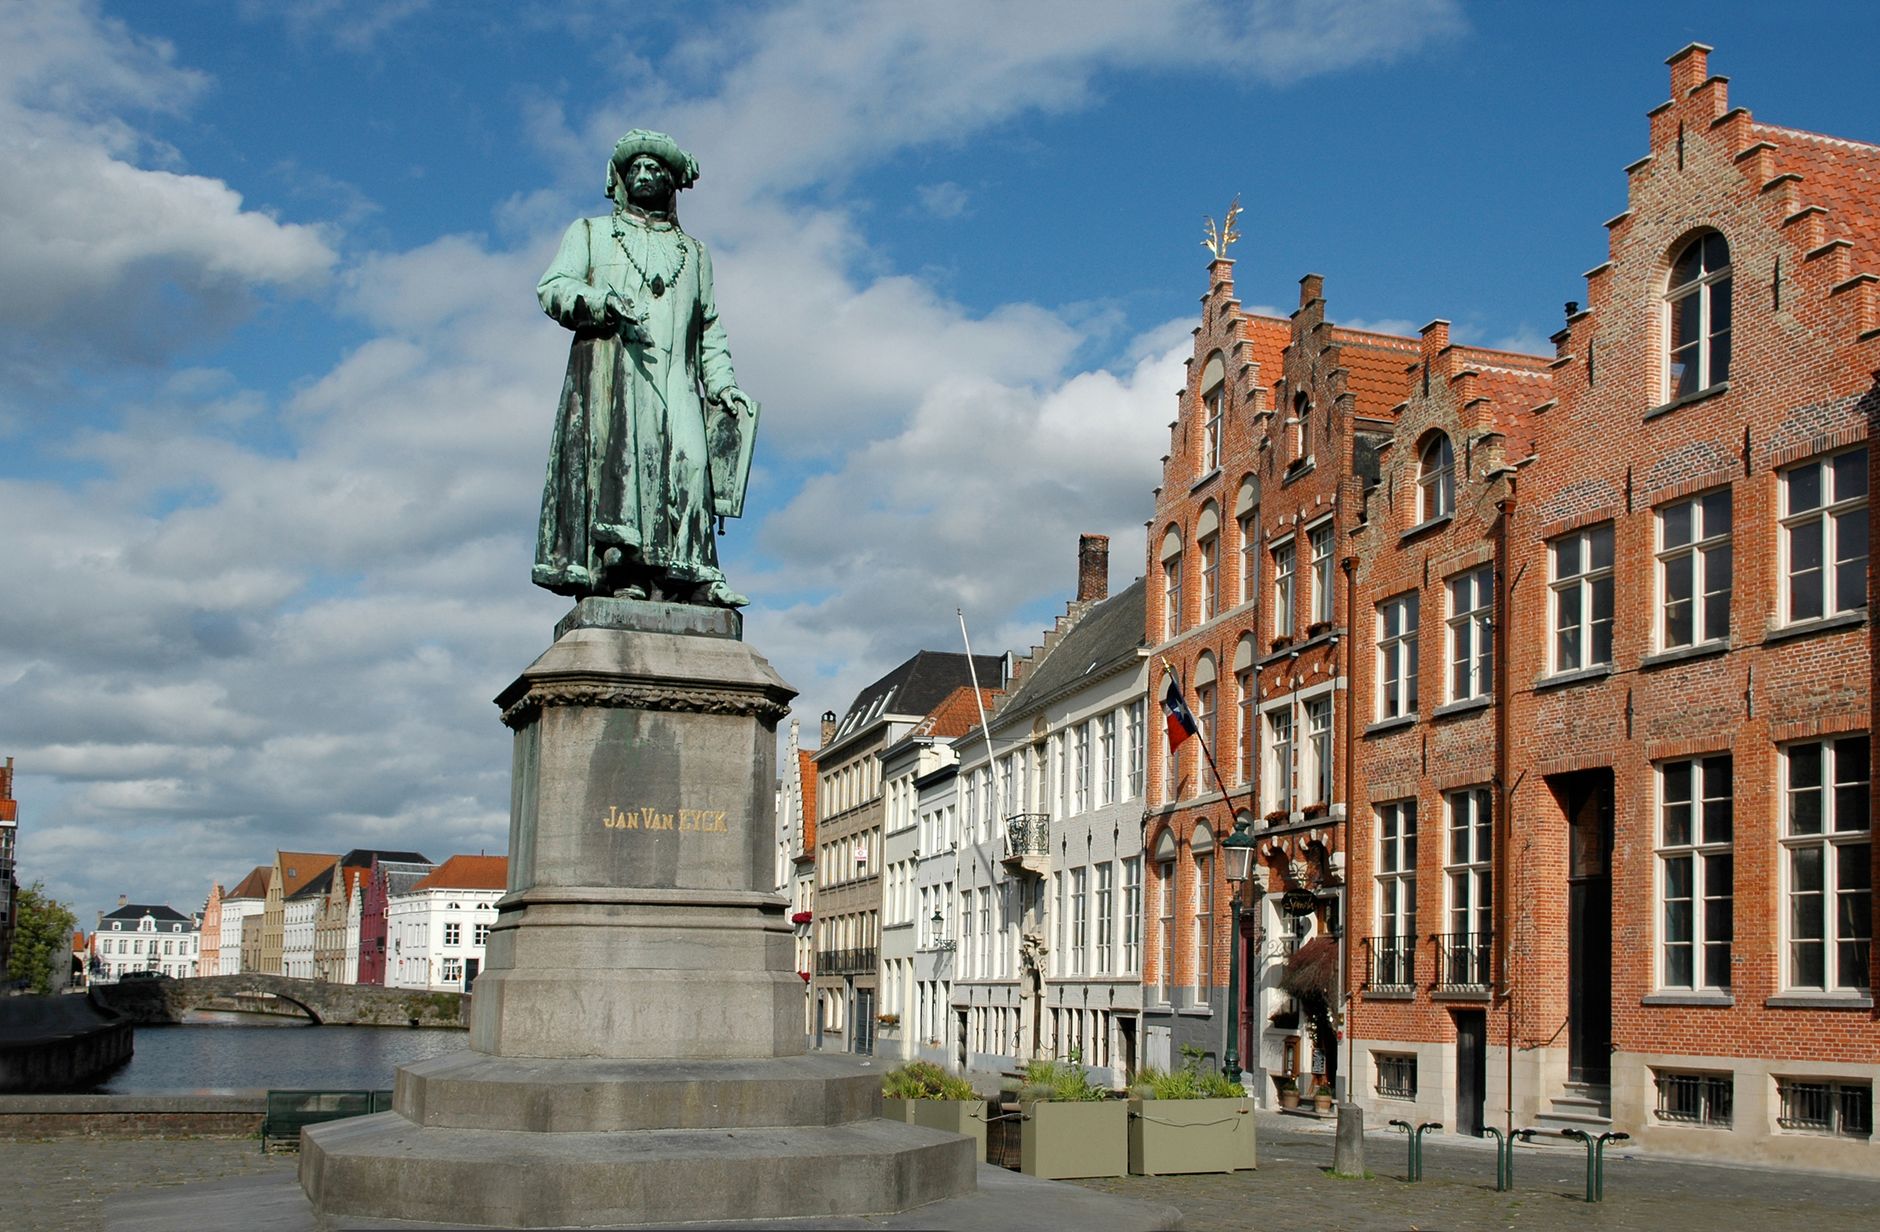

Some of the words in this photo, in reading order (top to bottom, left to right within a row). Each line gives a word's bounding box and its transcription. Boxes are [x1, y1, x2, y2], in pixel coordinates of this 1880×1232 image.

[603, 806, 639, 829] JAN
[641, 807, 674, 830] VAN
[679, 809, 728, 832] EYCK
